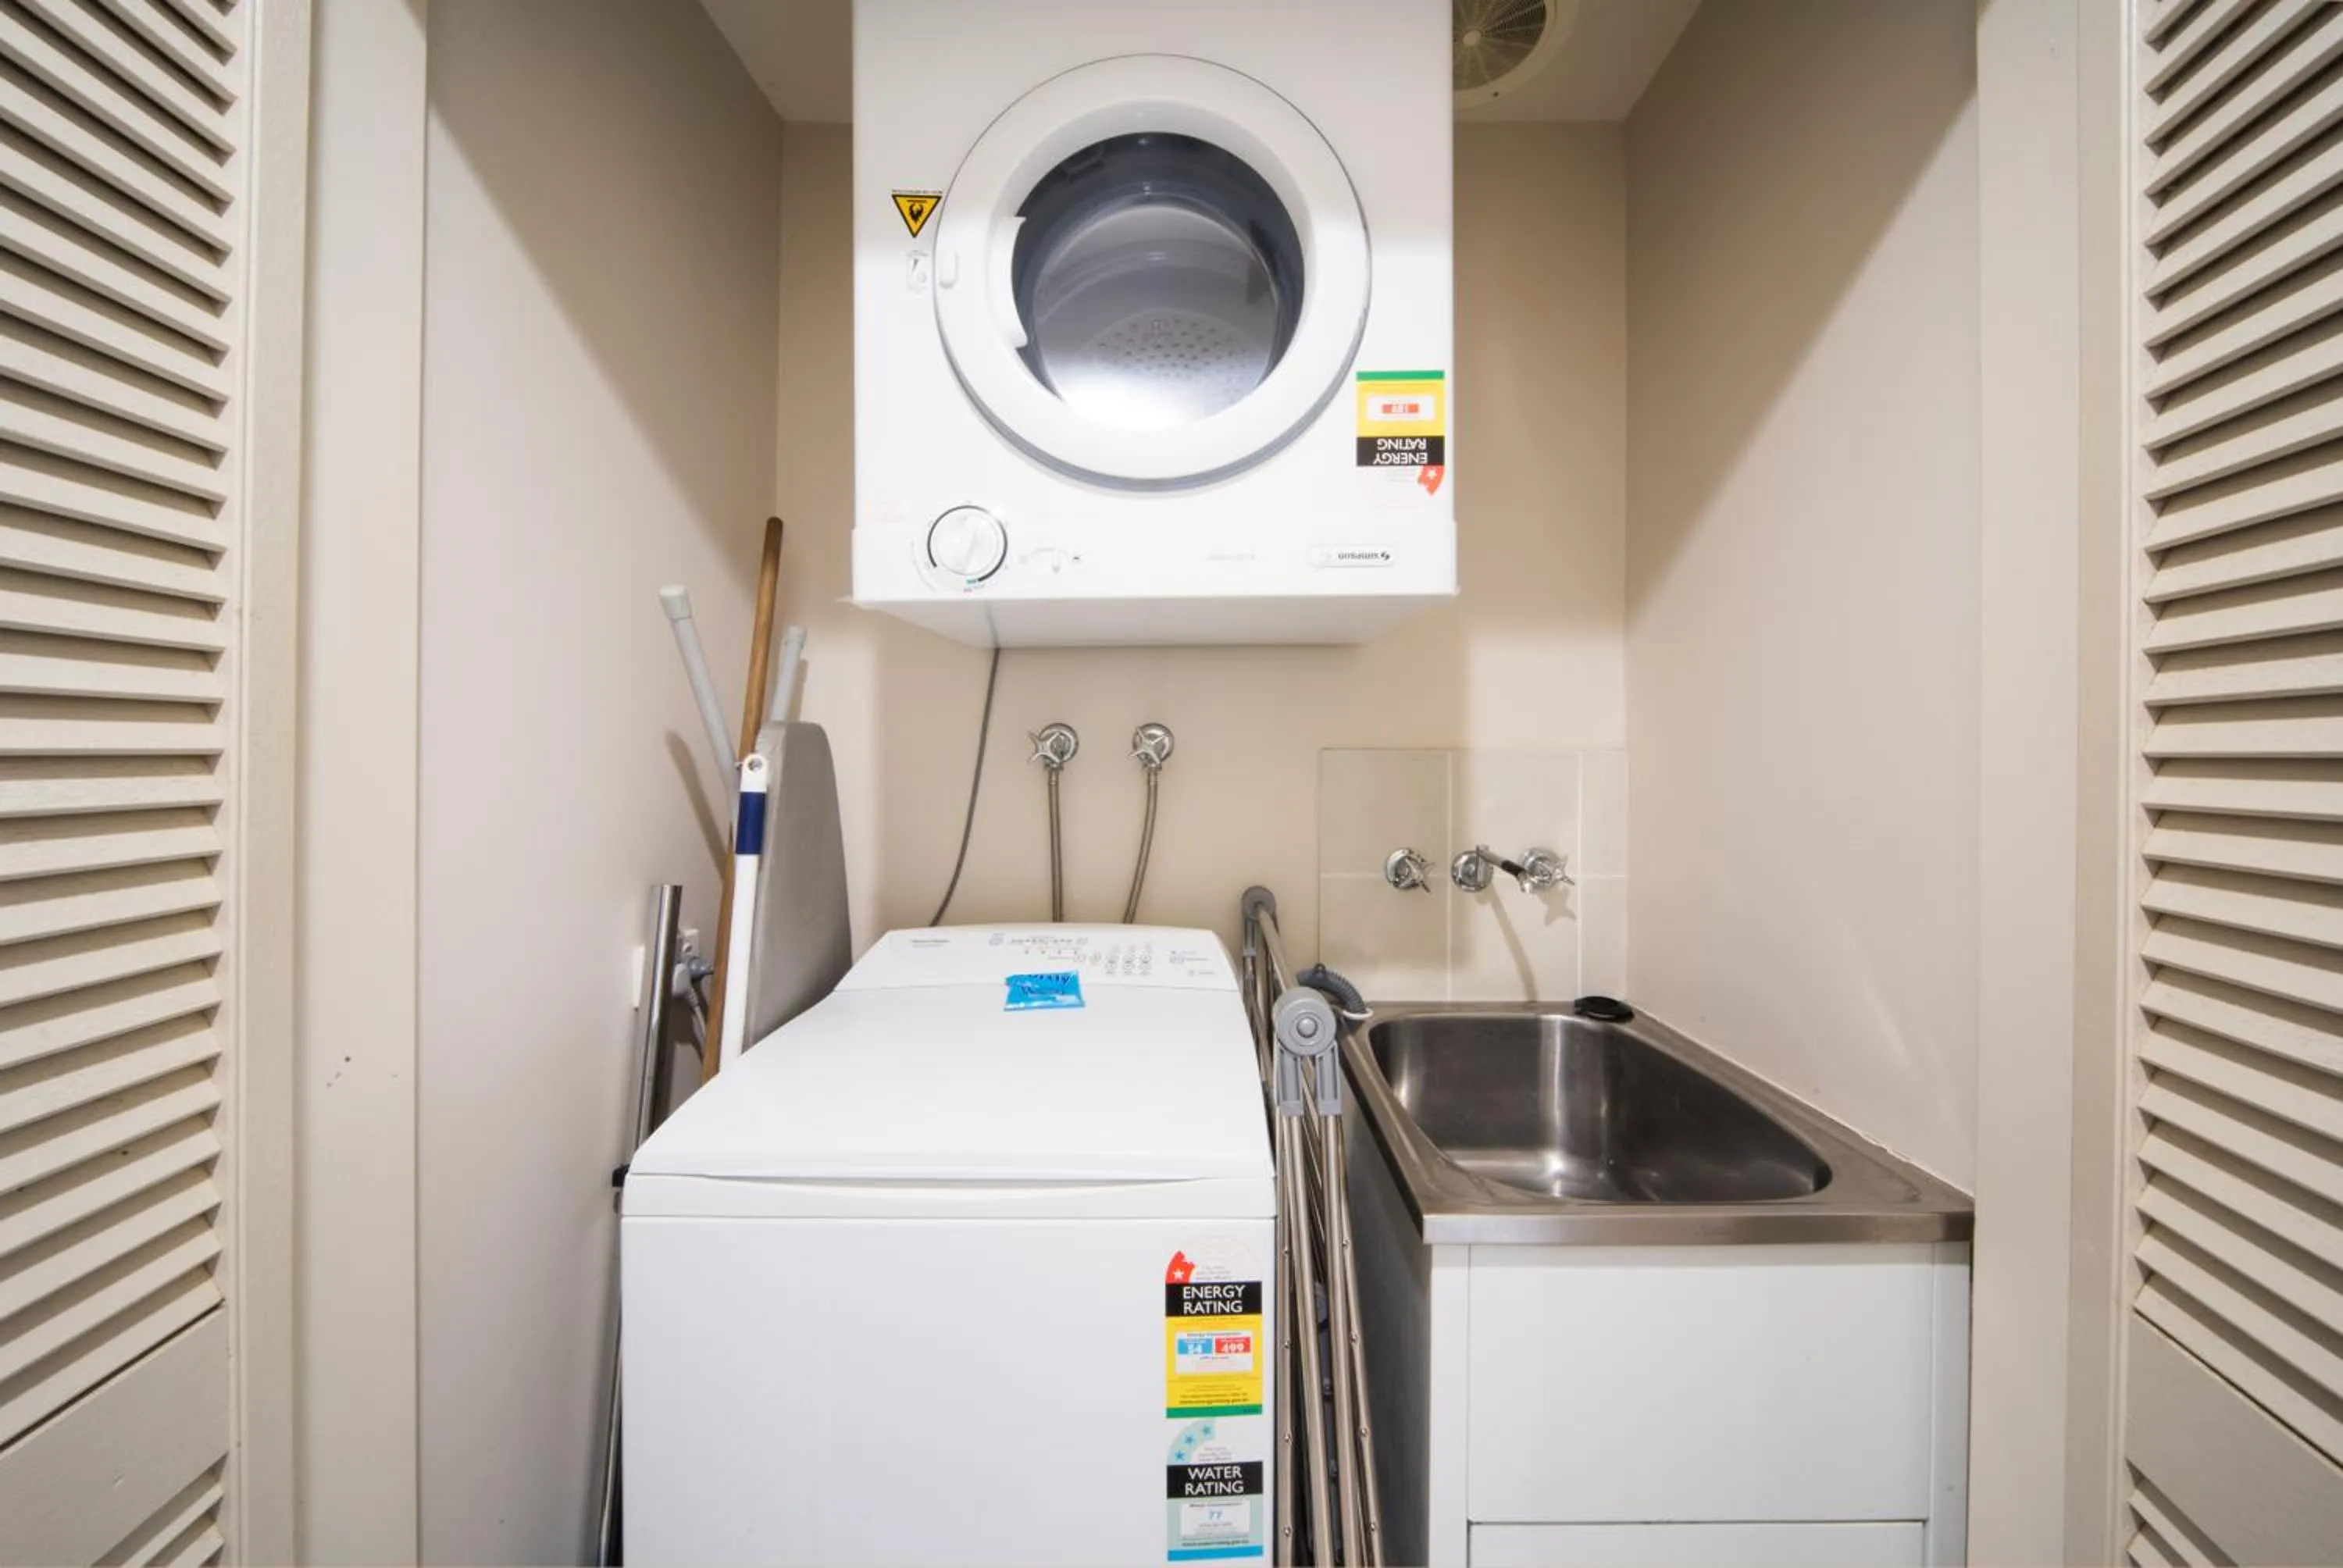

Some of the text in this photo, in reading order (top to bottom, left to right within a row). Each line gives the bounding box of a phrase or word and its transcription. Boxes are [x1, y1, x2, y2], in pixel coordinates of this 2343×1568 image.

[1377, 438, 1427, 451] RATING
[1373, 452, 1428, 465] ENERGY
[1182, 1285, 1245, 1299] ENERGY
[1183, 1300, 1243, 1314] RATING
[1188, 1466, 1243, 1480] WATER
[1185, 1481, 1244, 1495] RATING
